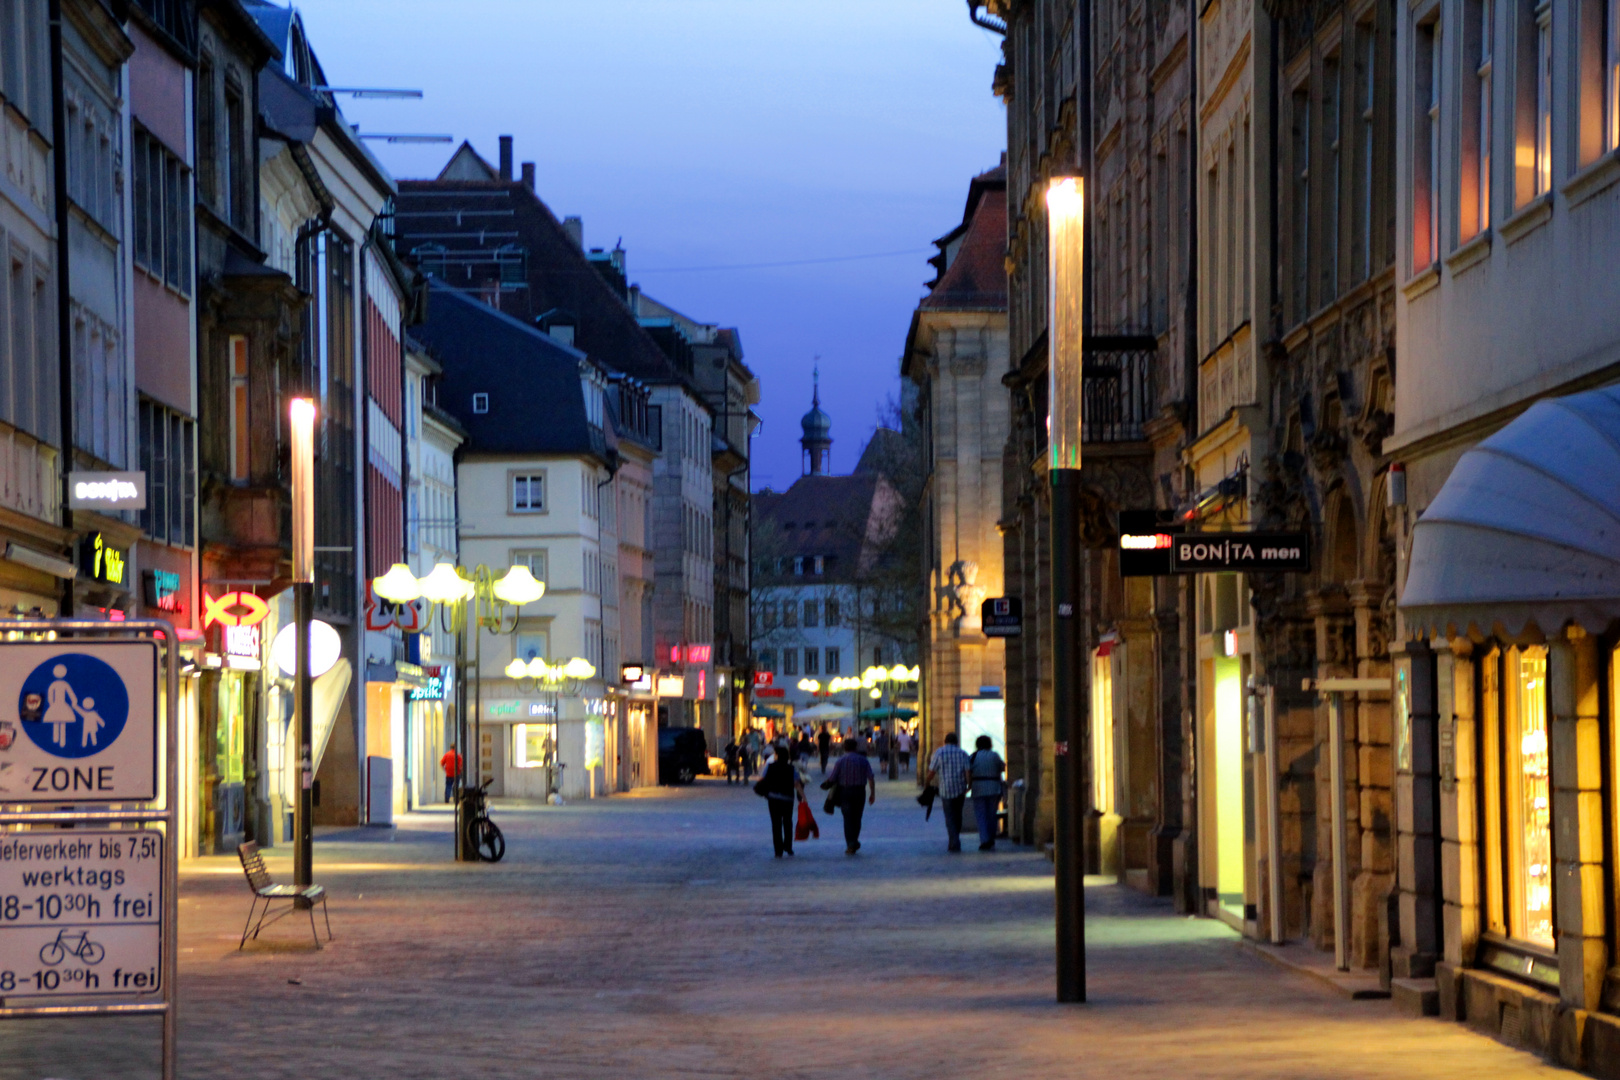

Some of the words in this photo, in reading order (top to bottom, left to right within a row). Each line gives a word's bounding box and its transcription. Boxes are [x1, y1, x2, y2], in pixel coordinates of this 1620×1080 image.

[1261, 546, 1300, 560] men
[32, 766, 115, 792] ZONE
[99, 838, 122, 859] bis
[128, 836, 157, 863] 7,5t
[23, 866, 126, 890] werktags
[113, 893, 153, 919] frei
[113, 967, 155, 989] frei
